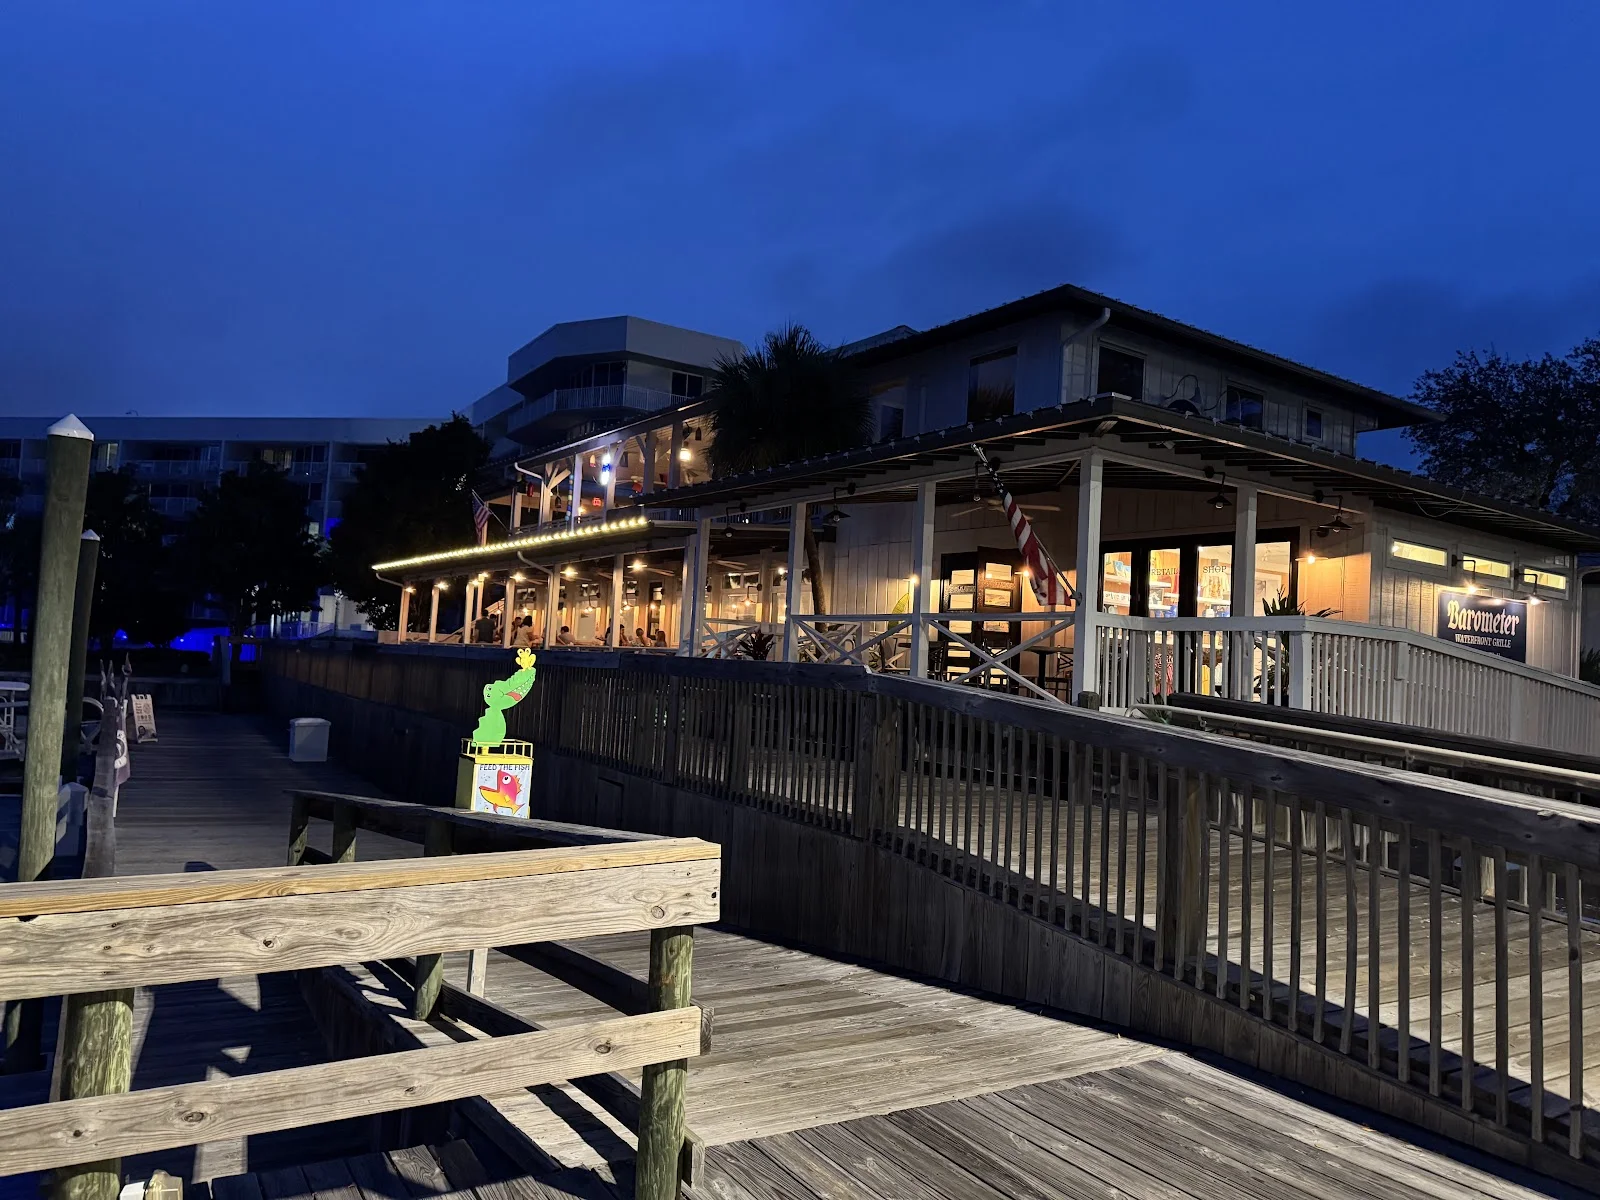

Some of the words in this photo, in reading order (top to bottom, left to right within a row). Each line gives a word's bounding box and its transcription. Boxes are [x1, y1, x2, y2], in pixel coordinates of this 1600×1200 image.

[1151, 568, 1179, 576] RETAIL
[1203, 565, 1226, 574] SHOP
[1447, 599, 1519, 637] Barometer
[1454, 633, 1493, 647] WATERFRONT
[1492, 638, 1511, 649] GRILLE
[480, 763, 498, 771] FEED
[499, 763, 513, 771] THE
[514, 763, 530, 771] FISH
